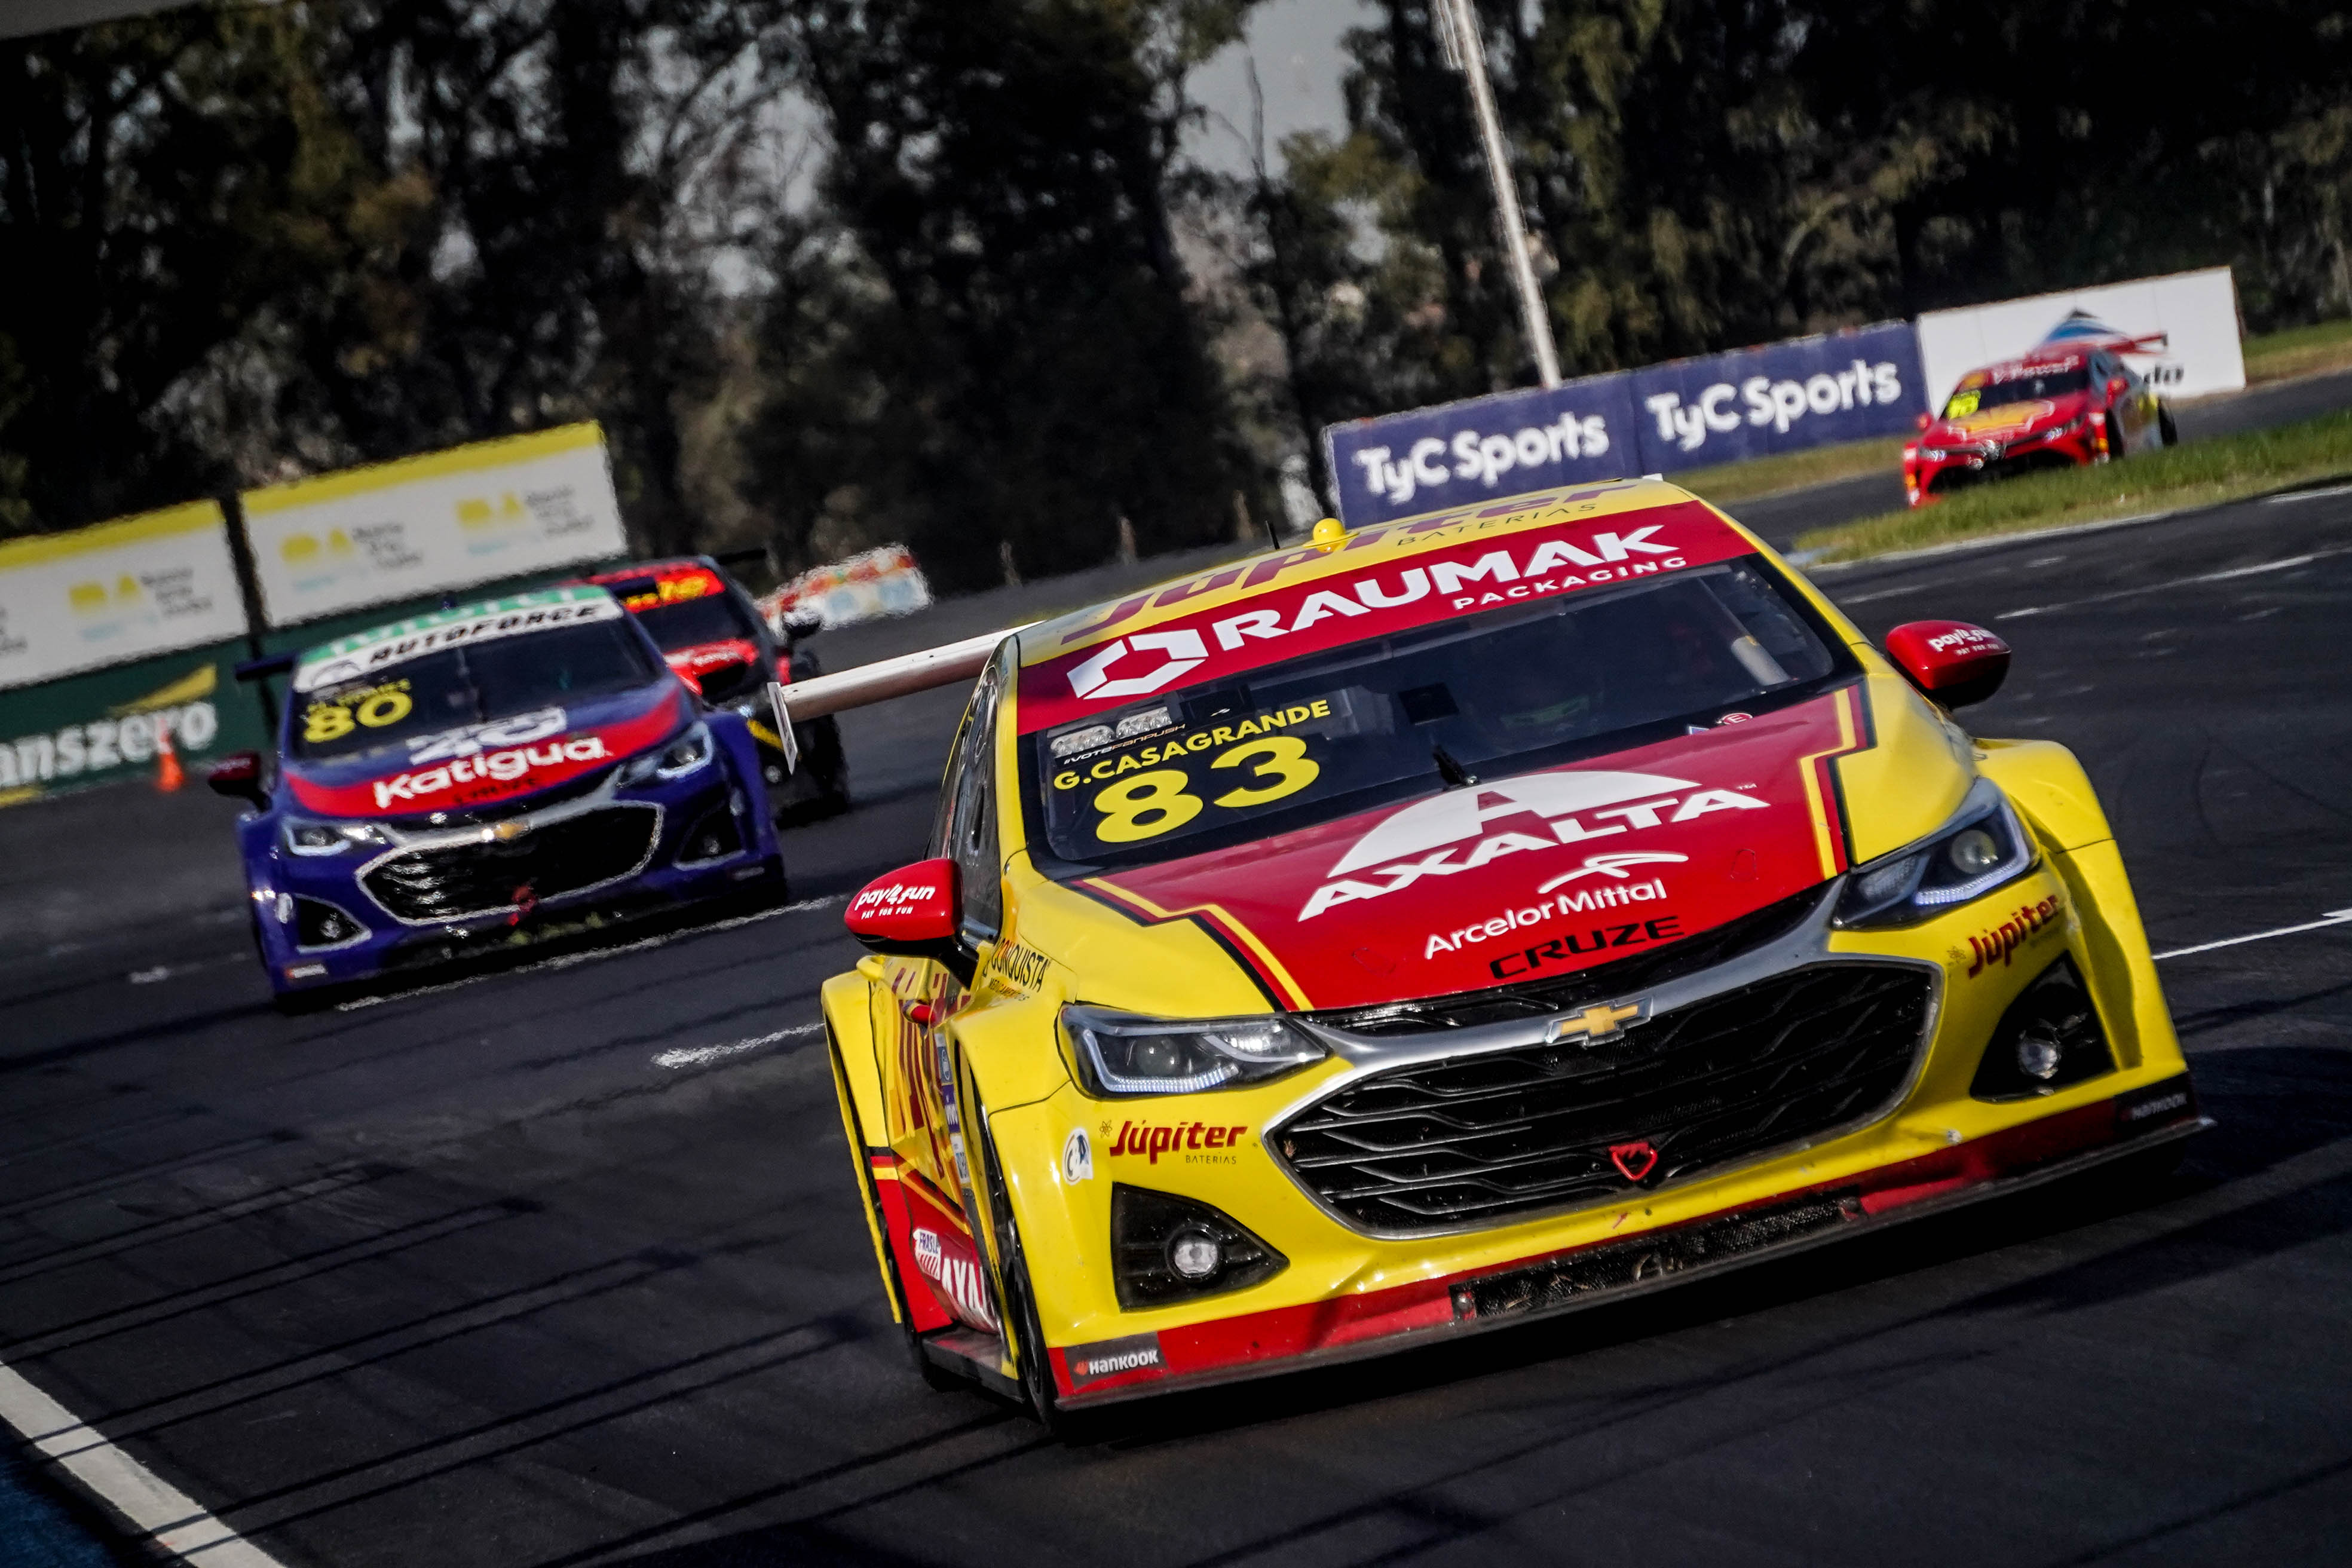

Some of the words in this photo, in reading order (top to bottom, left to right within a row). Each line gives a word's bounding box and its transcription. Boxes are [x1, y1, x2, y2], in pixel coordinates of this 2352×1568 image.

[1646, 383, 1741, 452] TyC
[1741, 359, 1903, 434] Sports
[1353, 436, 1450, 506] TyC
[1451, 411, 1610, 487] Sports
[1397, 503, 1597, 546] BATERIAS
[1212, 524, 1680, 651] RAUMAK
[1453, 556, 1687, 610] PACKAGING
[304, 691, 412, 743] 80
[1054, 699, 1331, 790] G.CASAGRANDE
[374, 737, 607, 808] Katigua
[1094, 736, 1320, 843] 83
[1297, 789, 1771, 923] AXALTA
[861, 909, 875, 920] PAY
[878, 906, 894, 916] FOR
[896, 905, 914, 914] FUN
[990, 938, 1048, 993] CONQUISTA
[1489, 915, 1685, 980] CRUZE
[1109, 1120, 1248, 1165] Júpiter
